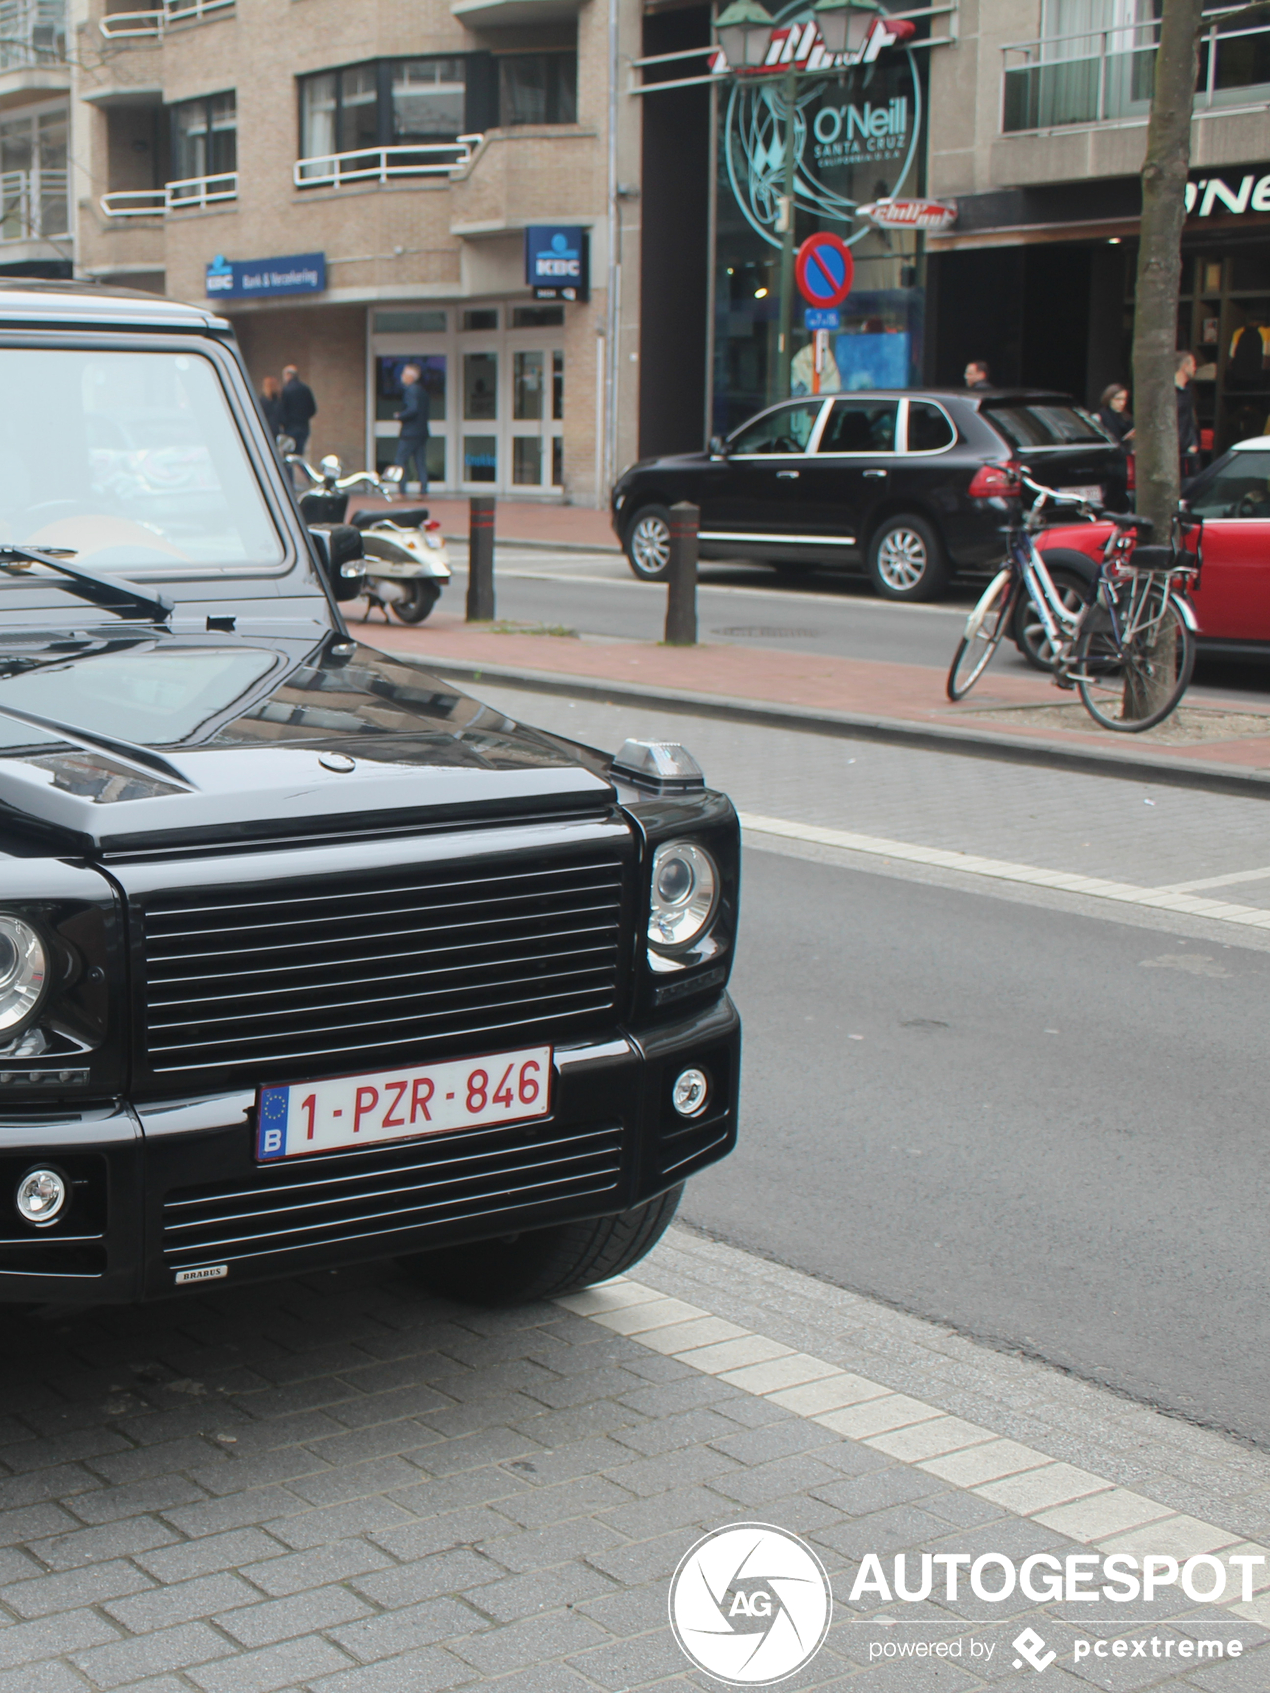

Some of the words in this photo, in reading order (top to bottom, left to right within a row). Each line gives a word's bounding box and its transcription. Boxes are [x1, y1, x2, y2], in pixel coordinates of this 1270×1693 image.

[813, 96, 907, 144] O'Neill
[814, 140, 860, 159] SANTA
[866, 134, 905, 152] CRUZ
[535, 259, 580, 277] KBC
[242, 273, 261, 290] Bank
[262, 272, 270, 288] &
[263, 1129, 282, 1152] B
[183, 1268, 221, 1280] BRABUS
